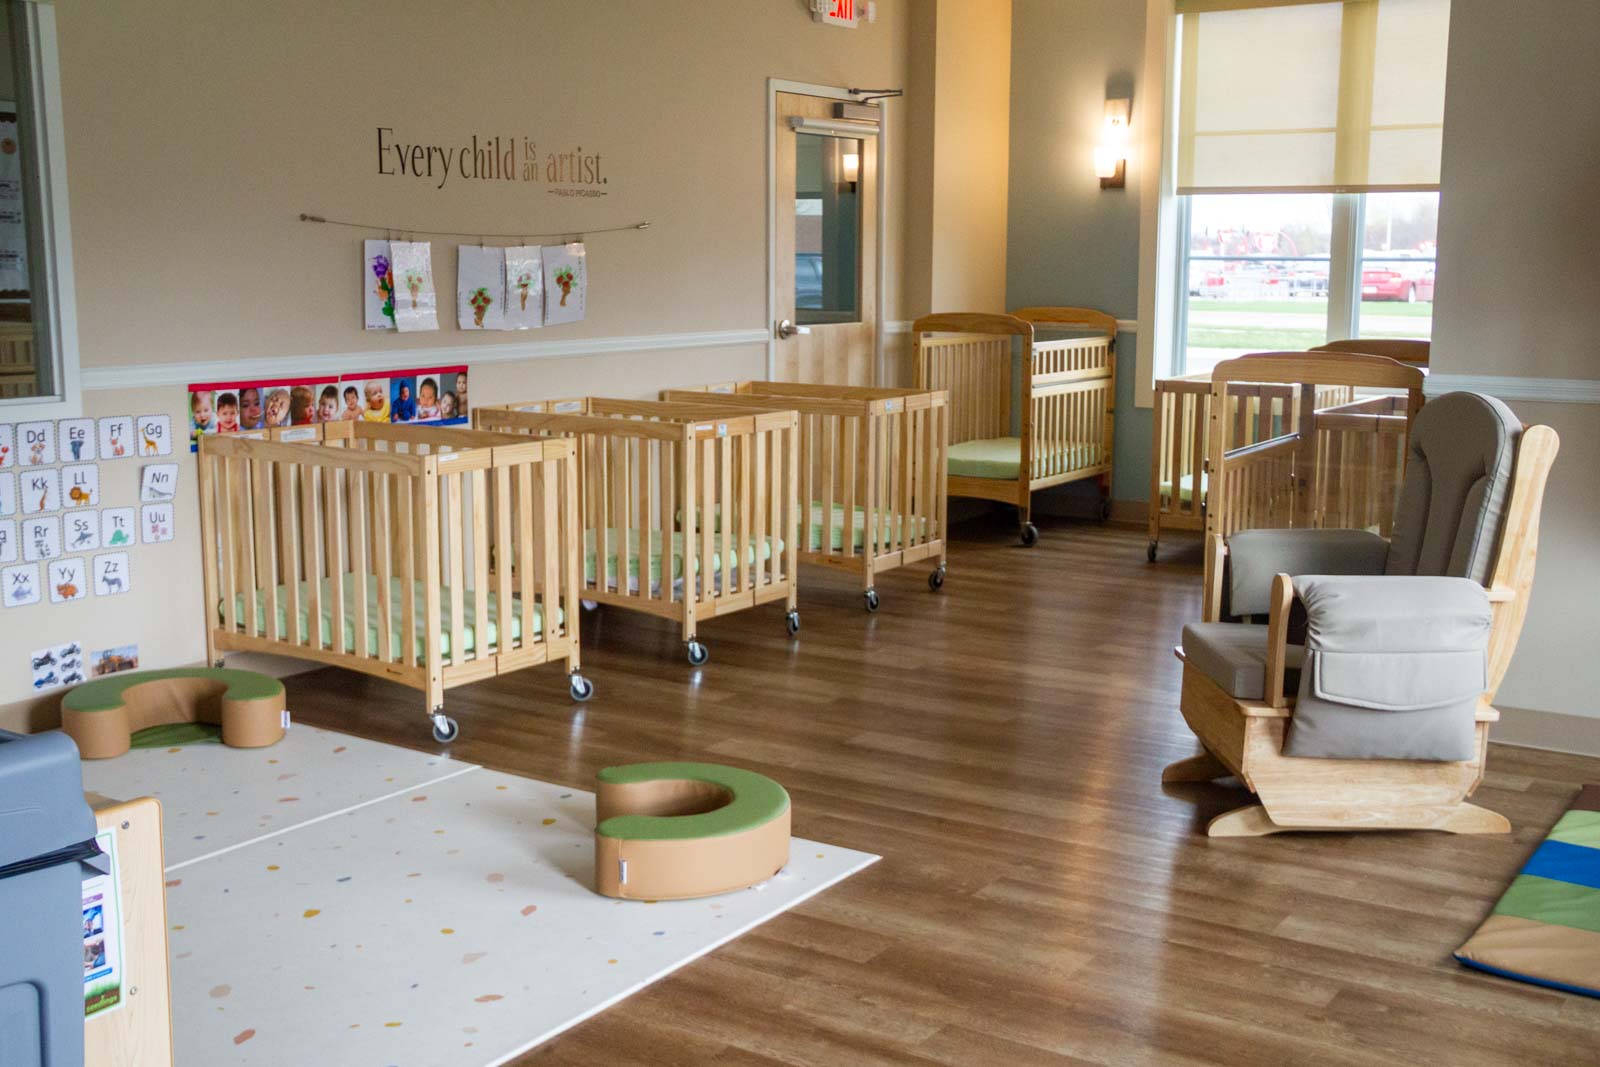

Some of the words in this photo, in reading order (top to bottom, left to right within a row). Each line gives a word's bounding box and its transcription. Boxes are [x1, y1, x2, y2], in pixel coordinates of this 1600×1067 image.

[523, 136, 537, 161] is
[376, 127, 453, 189] Every
[460, 135, 515, 181] child
[547, 146, 608, 184] artist.
[523, 162, 538, 182] an
[26, 429, 46, 444] Dd
[69, 426, 86, 440] Ee
[110, 423, 124, 437] Ff
[145, 423, 163, 438] Gg
[32, 477, 48, 491] Kk
[74, 471, 87, 485] Ll
[151, 472, 169, 483] Nn
[112, 515, 125, 528] Tt
[149, 512, 166, 524] Uu
[34, 525, 49, 539] Rr
[74, 519, 89, 532] Ss
[58, 567, 76, 582] Yy
[104, 561, 119, 574] Zz
[12, 572, 30, 585] Xx
